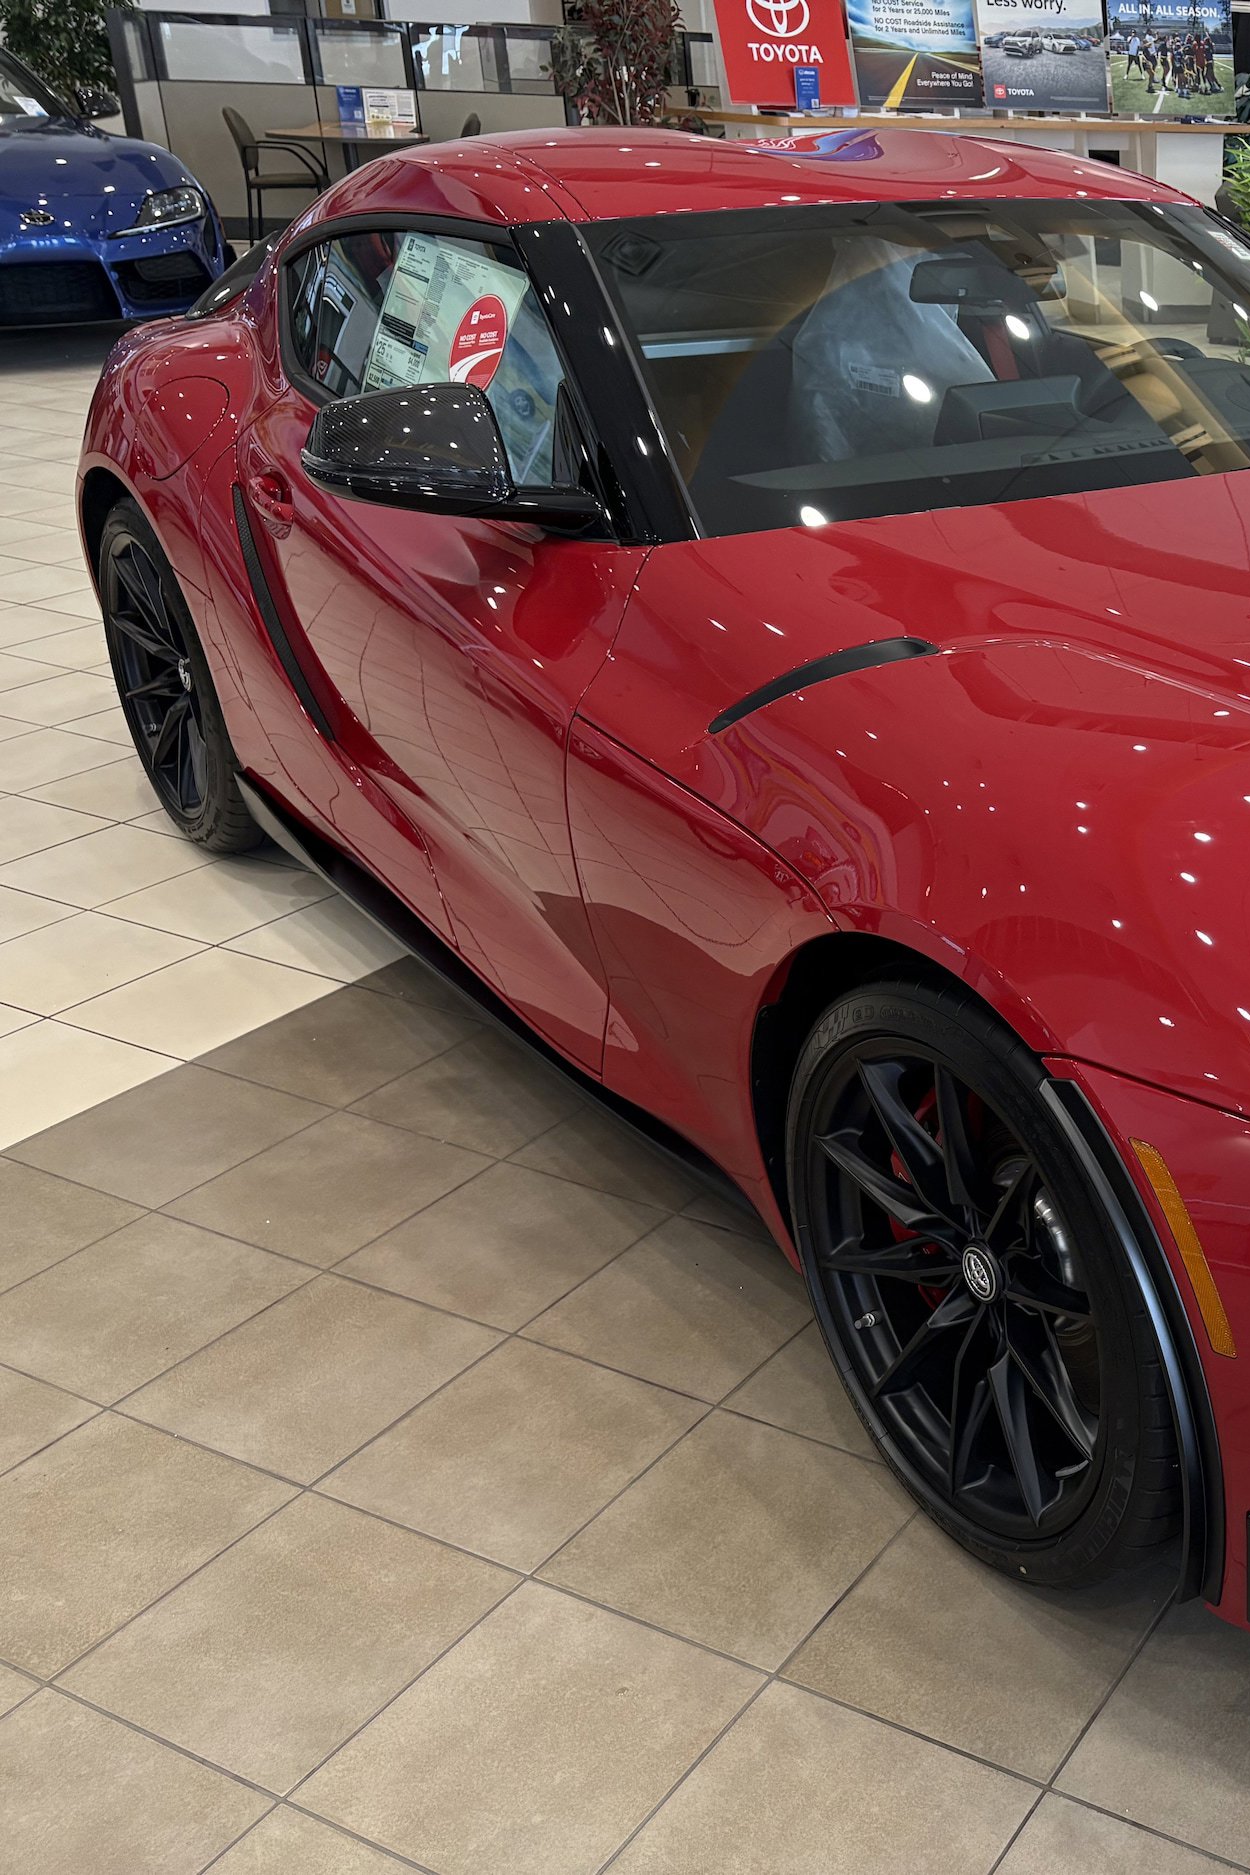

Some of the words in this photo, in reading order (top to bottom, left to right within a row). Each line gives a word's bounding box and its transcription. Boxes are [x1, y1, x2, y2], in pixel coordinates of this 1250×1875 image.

[888, 6, 905, 14] Years
[1021, 0, 1067, 14] worry.
[1118, 3, 1137, 14] ALL
[1139, 3, 1154, 15] IN.
[1155, 5, 1174, 16] ALL
[1175, 5, 1221, 18] SEASON.
[885, 17, 902, 25] COST
[903, 18, 932, 27] Roadside
[933, 20, 965, 28] Assistance
[921, 27, 949, 35] Unlimited
[747, 43, 824, 64] TOYOTA
[931, 71, 950, 79] Peace
[958, 72, 973, 80] Mind
[917, 78, 951, 88] Everywhere
[951, 79, 963, 87] You
[1007, 88, 1035, 96] TOYOTA
